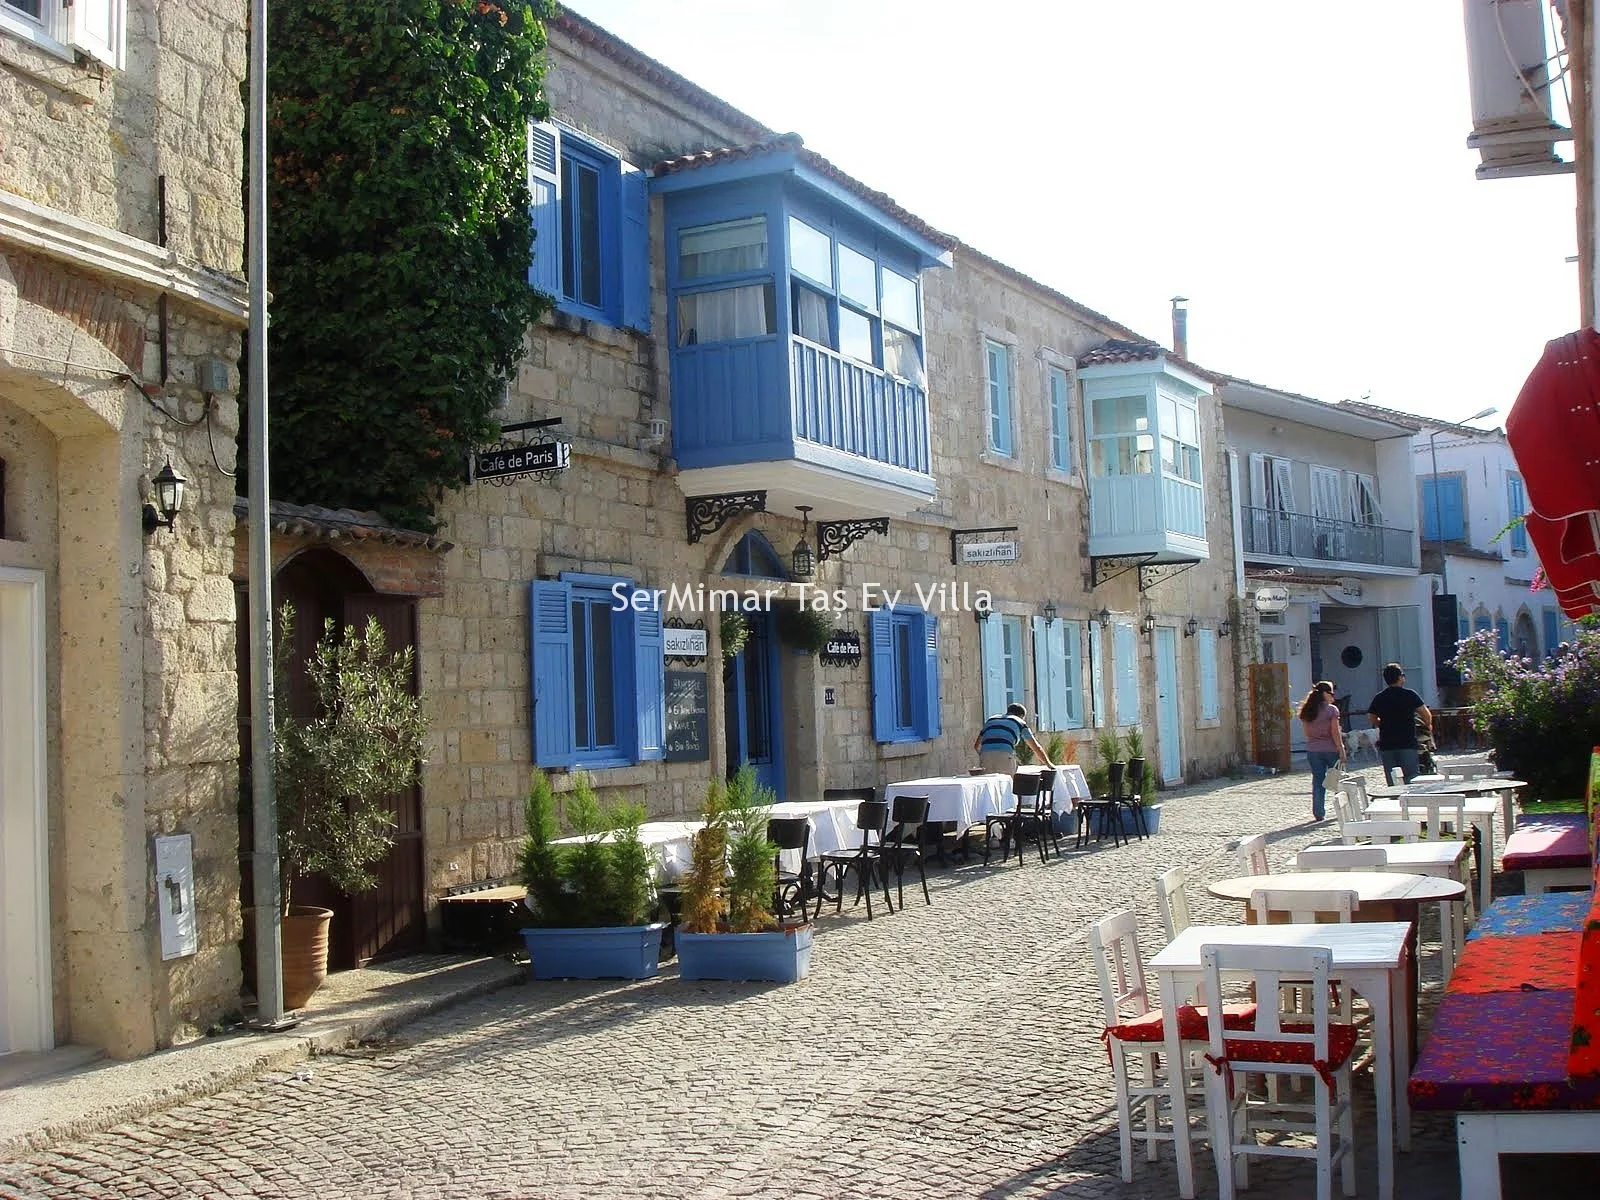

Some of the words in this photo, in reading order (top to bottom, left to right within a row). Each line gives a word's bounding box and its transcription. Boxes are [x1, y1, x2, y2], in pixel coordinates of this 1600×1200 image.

[480, 456, 505, 472] Café
[508, 454, 522, 468] de
[525, 450, 553, 466] Paris
[827, 641, 840, 654] Café
[840, 642, 847, 654] de
[847, 643, 860, 654] Paris
